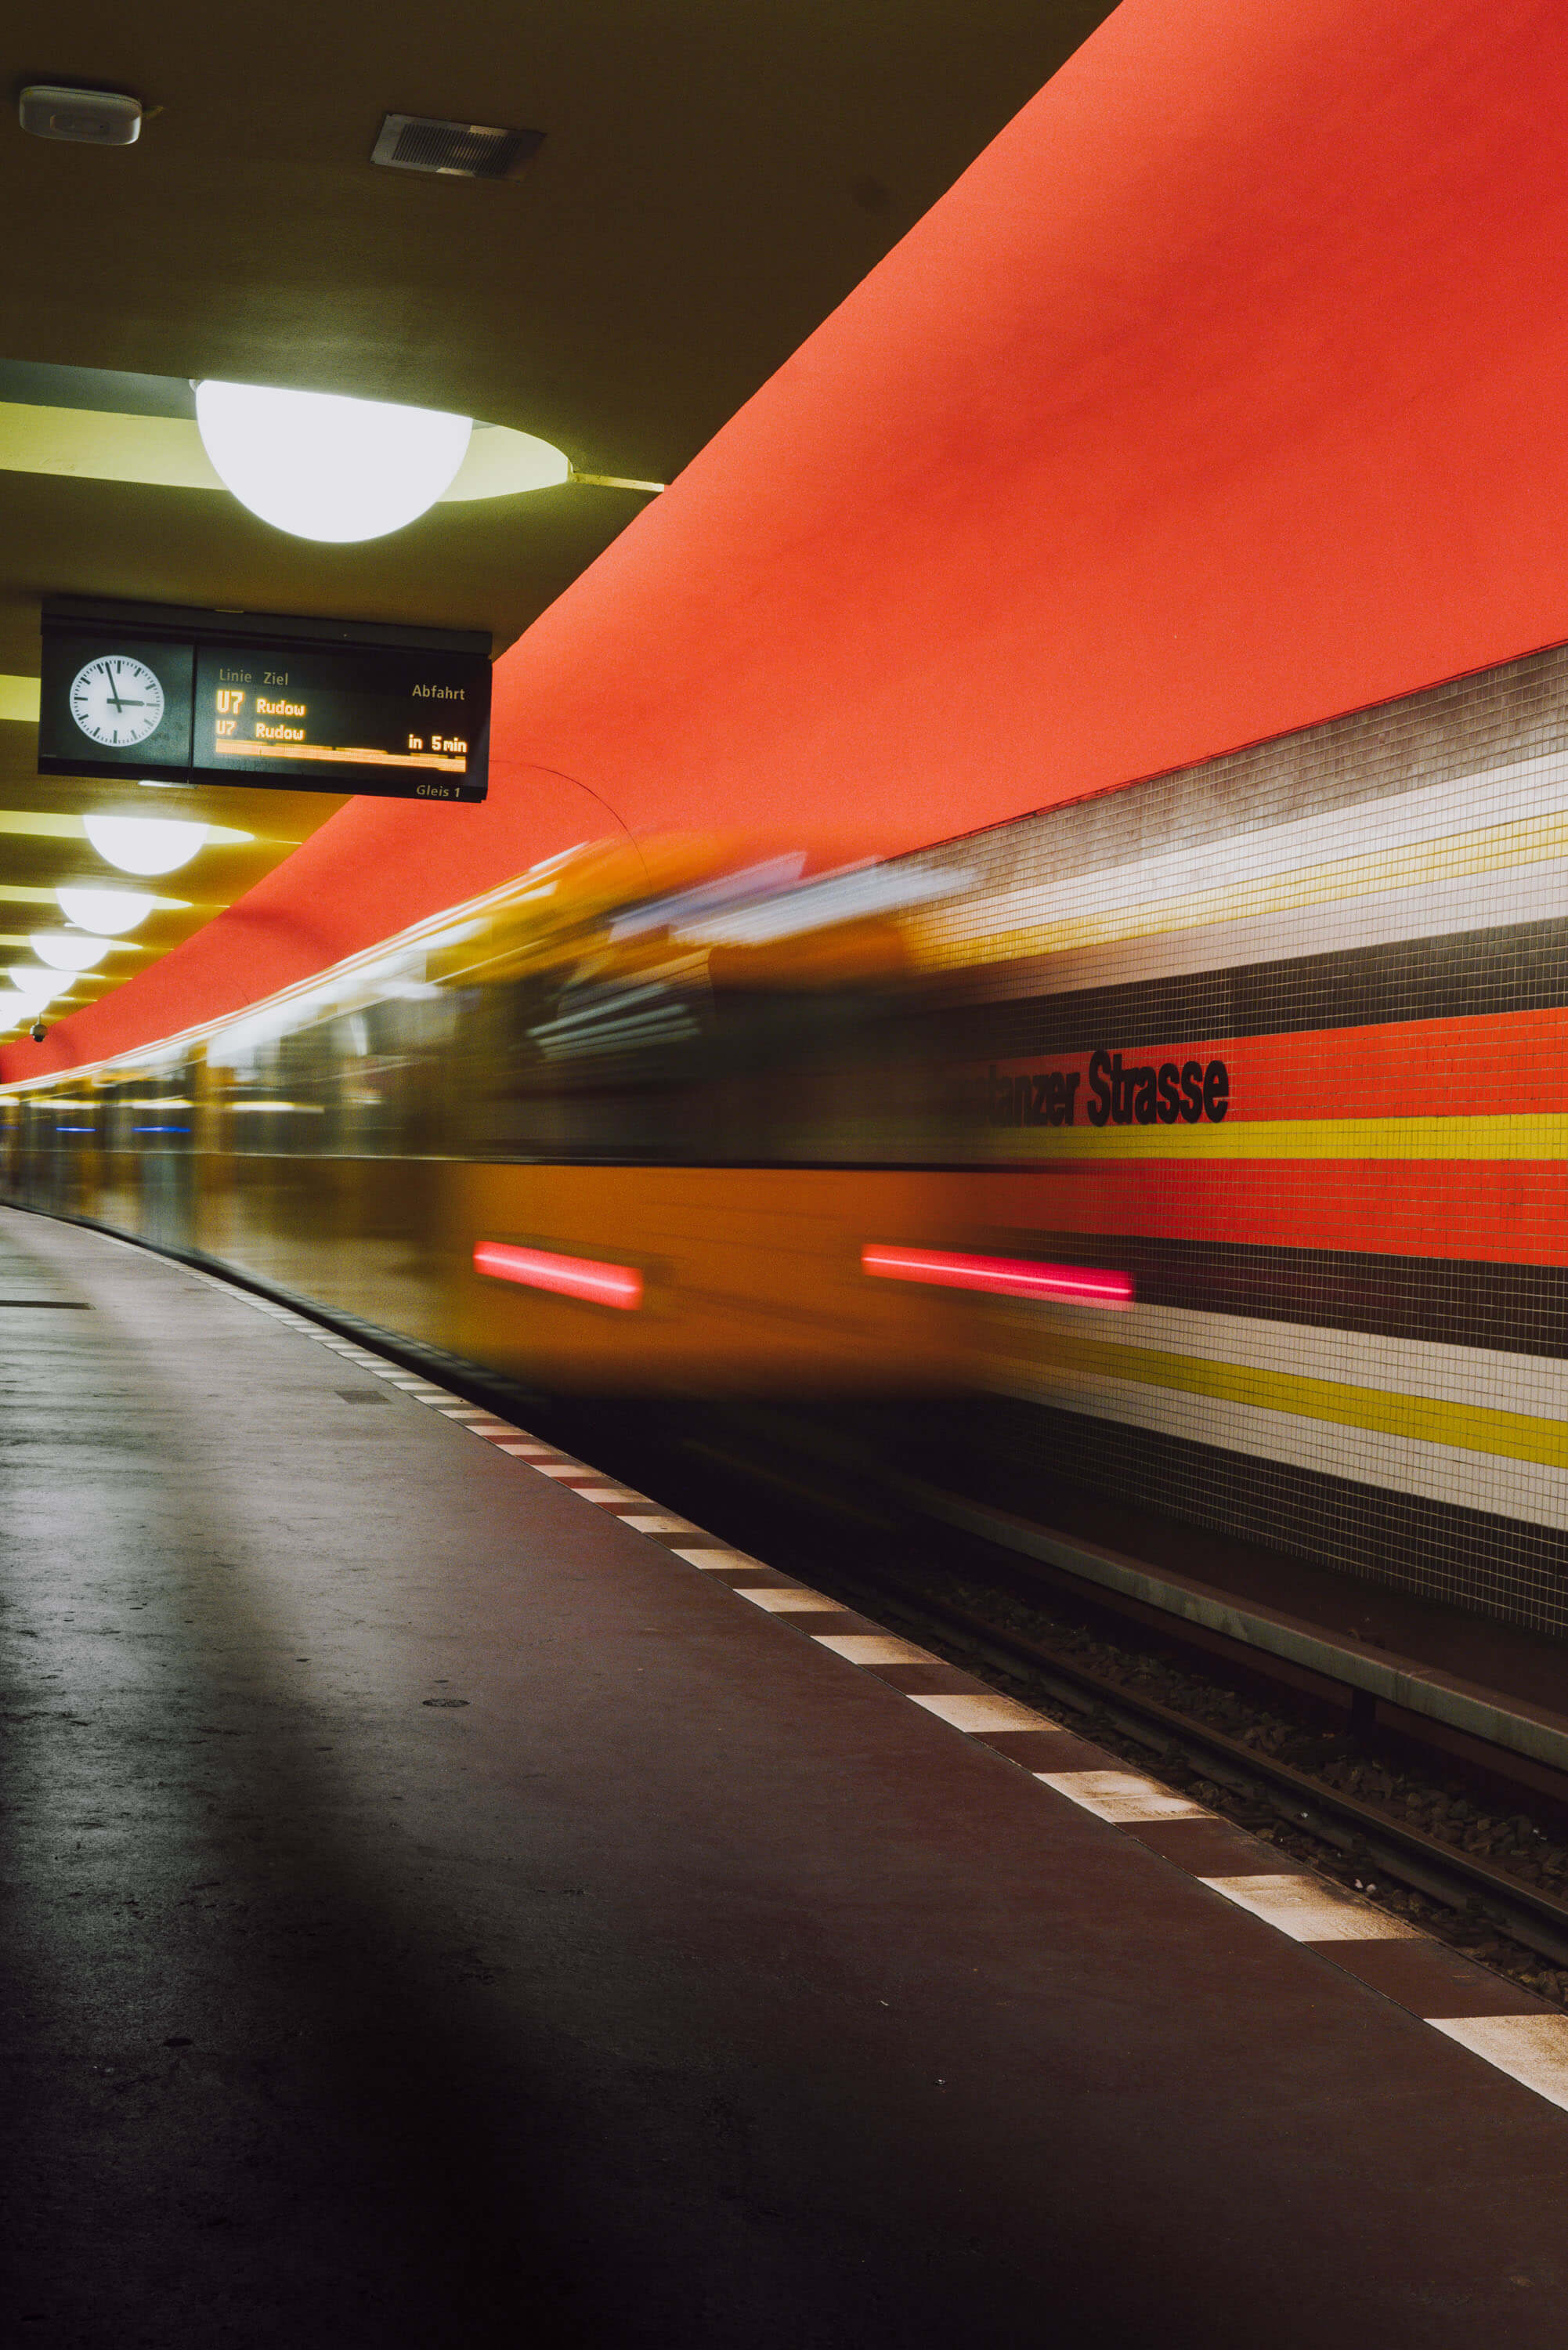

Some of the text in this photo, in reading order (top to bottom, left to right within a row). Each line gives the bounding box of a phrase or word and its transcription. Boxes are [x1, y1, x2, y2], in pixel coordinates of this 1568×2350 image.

[219, 668, 289, 685] Linie Ziel
[412, 684, 466, 700] Abfahrt
[216, 689, 306, 717] U7 Rudow
[215, 719, 305, 740] U7 Rudow
[408, 733, 424, 750] in
[416, 784, 461, 798] Gleis 1
[1087, 1047, 1230, 1128] Strasse
